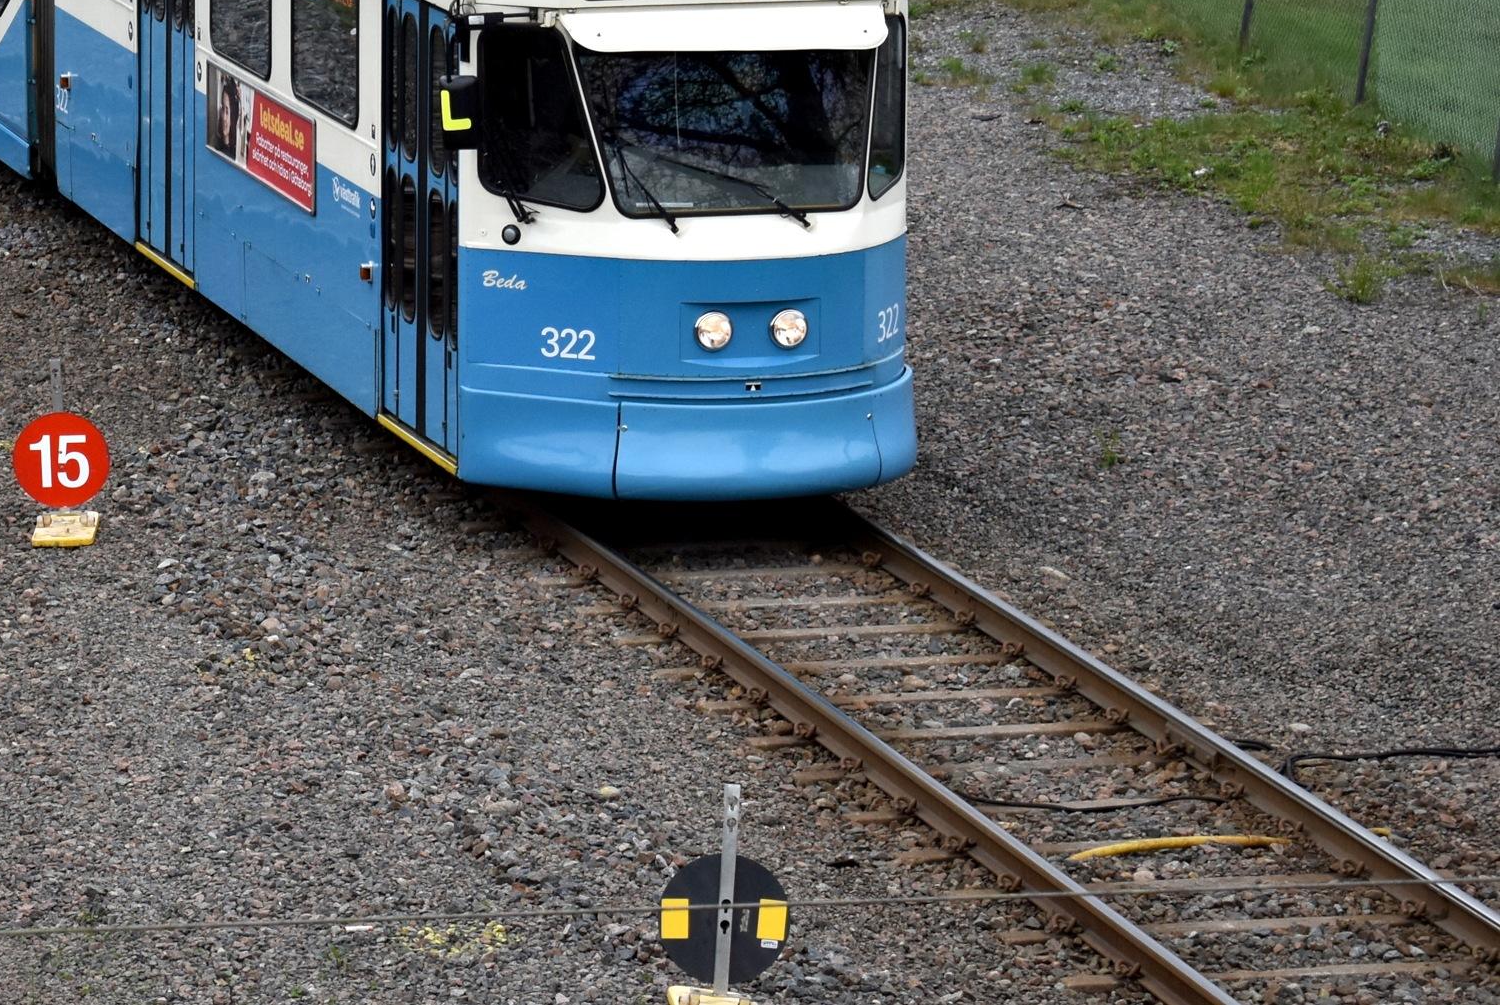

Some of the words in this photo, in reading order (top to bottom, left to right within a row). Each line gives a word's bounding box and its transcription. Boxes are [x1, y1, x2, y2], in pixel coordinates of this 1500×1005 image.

[260, 102, 305, 151] letsdeal.se
[482, 270, 527, 290] Beda
[877, 303, 899, 343] 322
[540, 327, 596, 361] 322
[29, 434, 90, 489] 15
